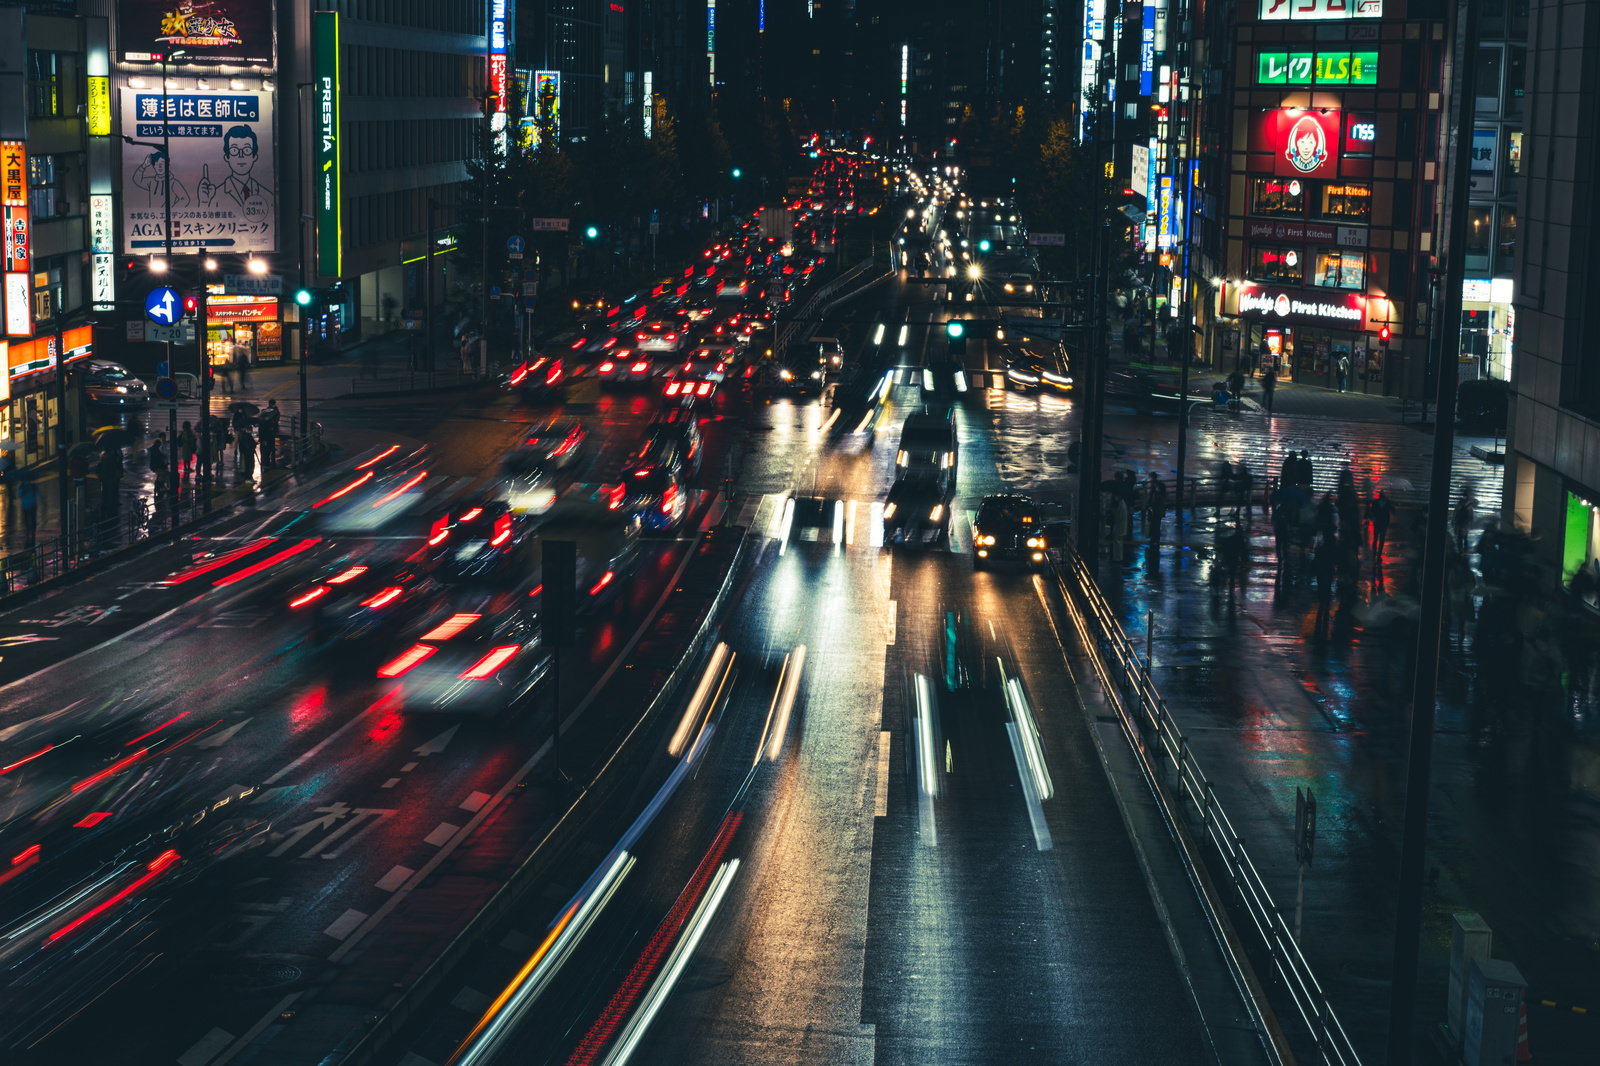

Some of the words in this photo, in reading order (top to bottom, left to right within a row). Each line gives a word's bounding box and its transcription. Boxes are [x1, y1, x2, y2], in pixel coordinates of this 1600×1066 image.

[141, 98, 256, 118] 薄毛は医師に。
[6, 152, 22, 200] 大黒屋
[130, 211, 237, 220] 本気なら、エデンスのある治療法を。
[14, 218, 27, 260] 吉野家
[131, 223, 163, 236] AGA
[1287, 229, 1303, 237] First
[1306, 230, 1333, 239] Kitchen
[1292, 301, 1317, 315] First
[1318, 302, 1362, 320] Kitchen
